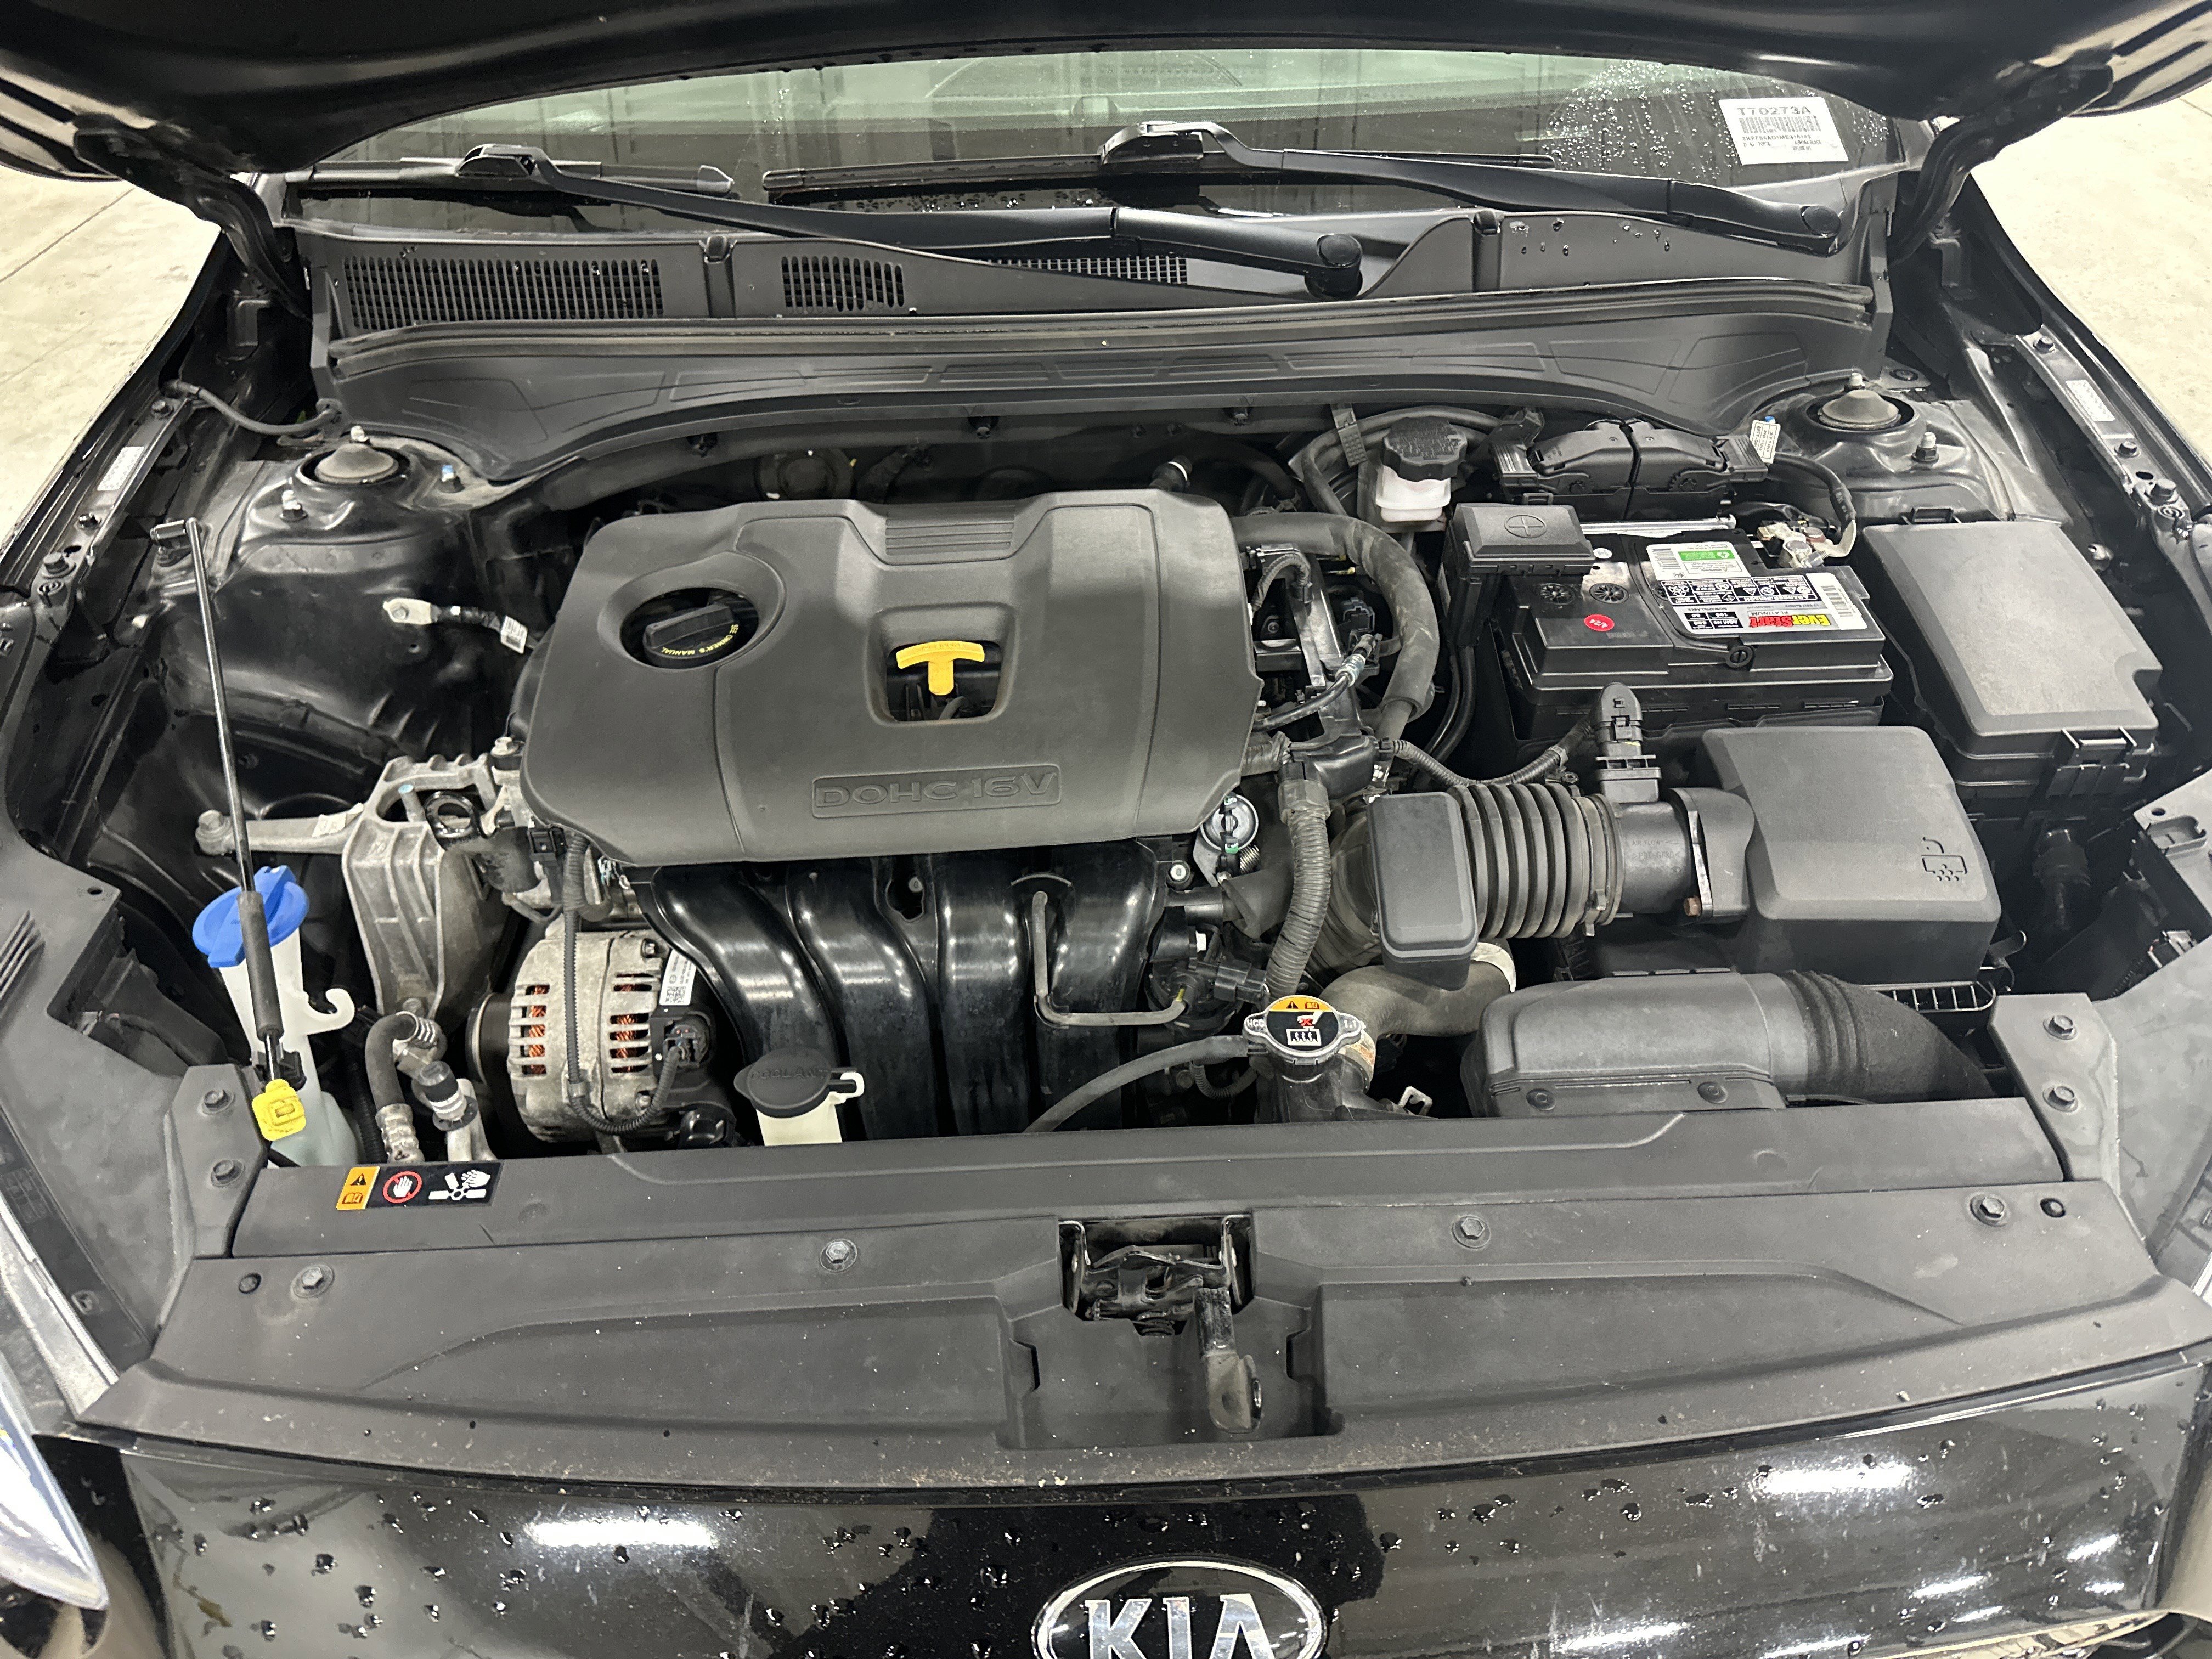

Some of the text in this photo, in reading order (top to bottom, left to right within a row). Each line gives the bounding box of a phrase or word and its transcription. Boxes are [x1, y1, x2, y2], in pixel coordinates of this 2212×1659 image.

[1736, 106, 1811, 116] T70273A
[1589, 618, 1609, 628] 4/24
[1749, 614, 1831, 628] EverStart
[661, 624, 740, 656] SEE OWNER'S MANUAL
[815, 771, 1058, 808] DOHC 16V
[1246, 1019, 1357, 1029] HCC 1.1
[749, 1066, 829, 1080] COOLANT
[1084, 1593, 1276, 1659] KIA
